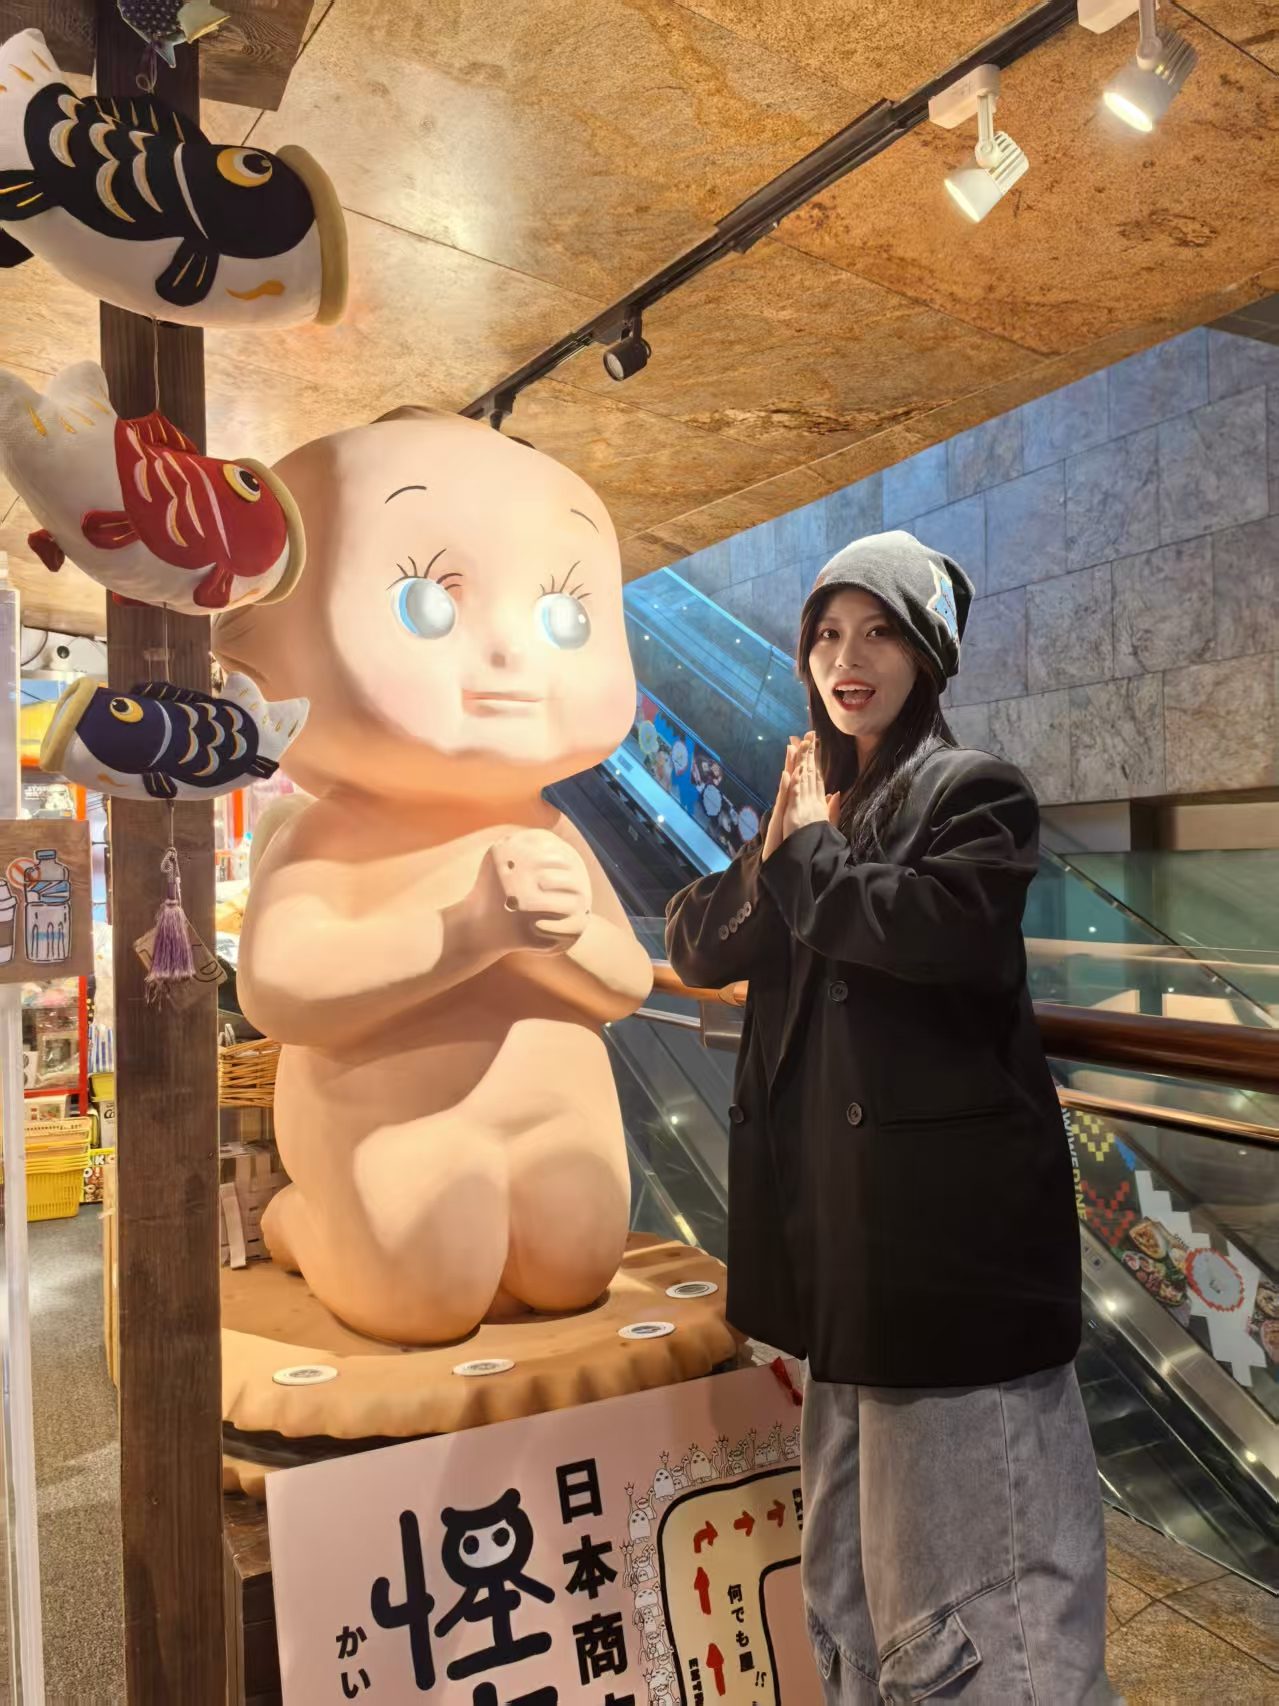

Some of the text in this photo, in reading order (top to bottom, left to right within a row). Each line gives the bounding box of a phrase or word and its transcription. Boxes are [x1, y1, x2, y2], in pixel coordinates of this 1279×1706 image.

[335, 1625, 371, 1699] かい
[371, 1487, 559, 1706] 怪
[555, 1458, 636, 1706] 日本商
